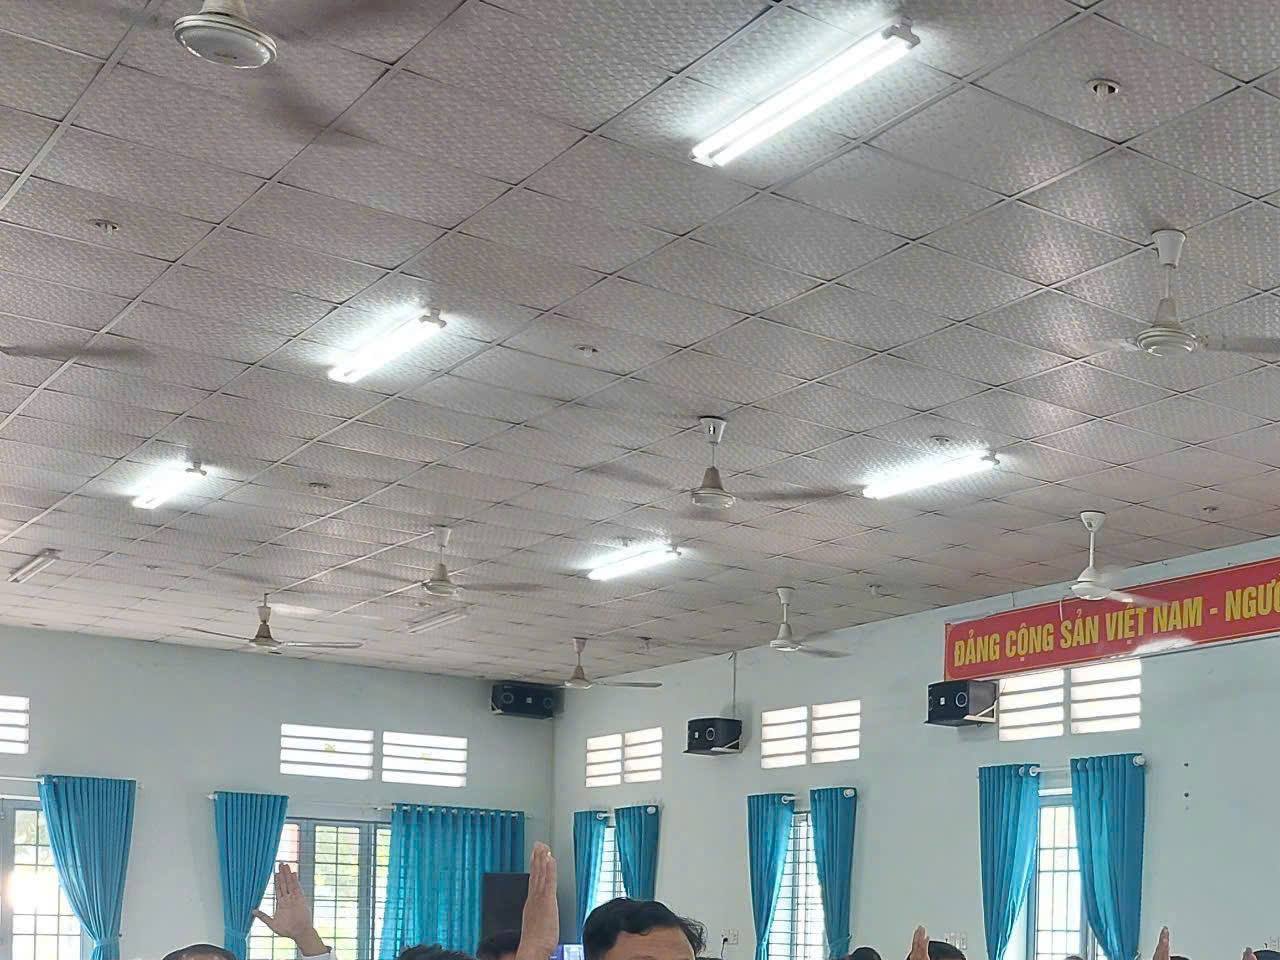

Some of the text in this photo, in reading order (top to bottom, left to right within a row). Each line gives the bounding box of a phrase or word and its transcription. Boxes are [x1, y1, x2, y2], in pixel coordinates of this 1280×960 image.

[954, 633, 1001, 668] ĐẢNG
[1005, 622, 1056, 662] CỘNG
[1059, 611, 1100, 650] SẢN
[1105, 599, 1146, 645] VIỆT
[1152, 596, 1203, 633] NAM
